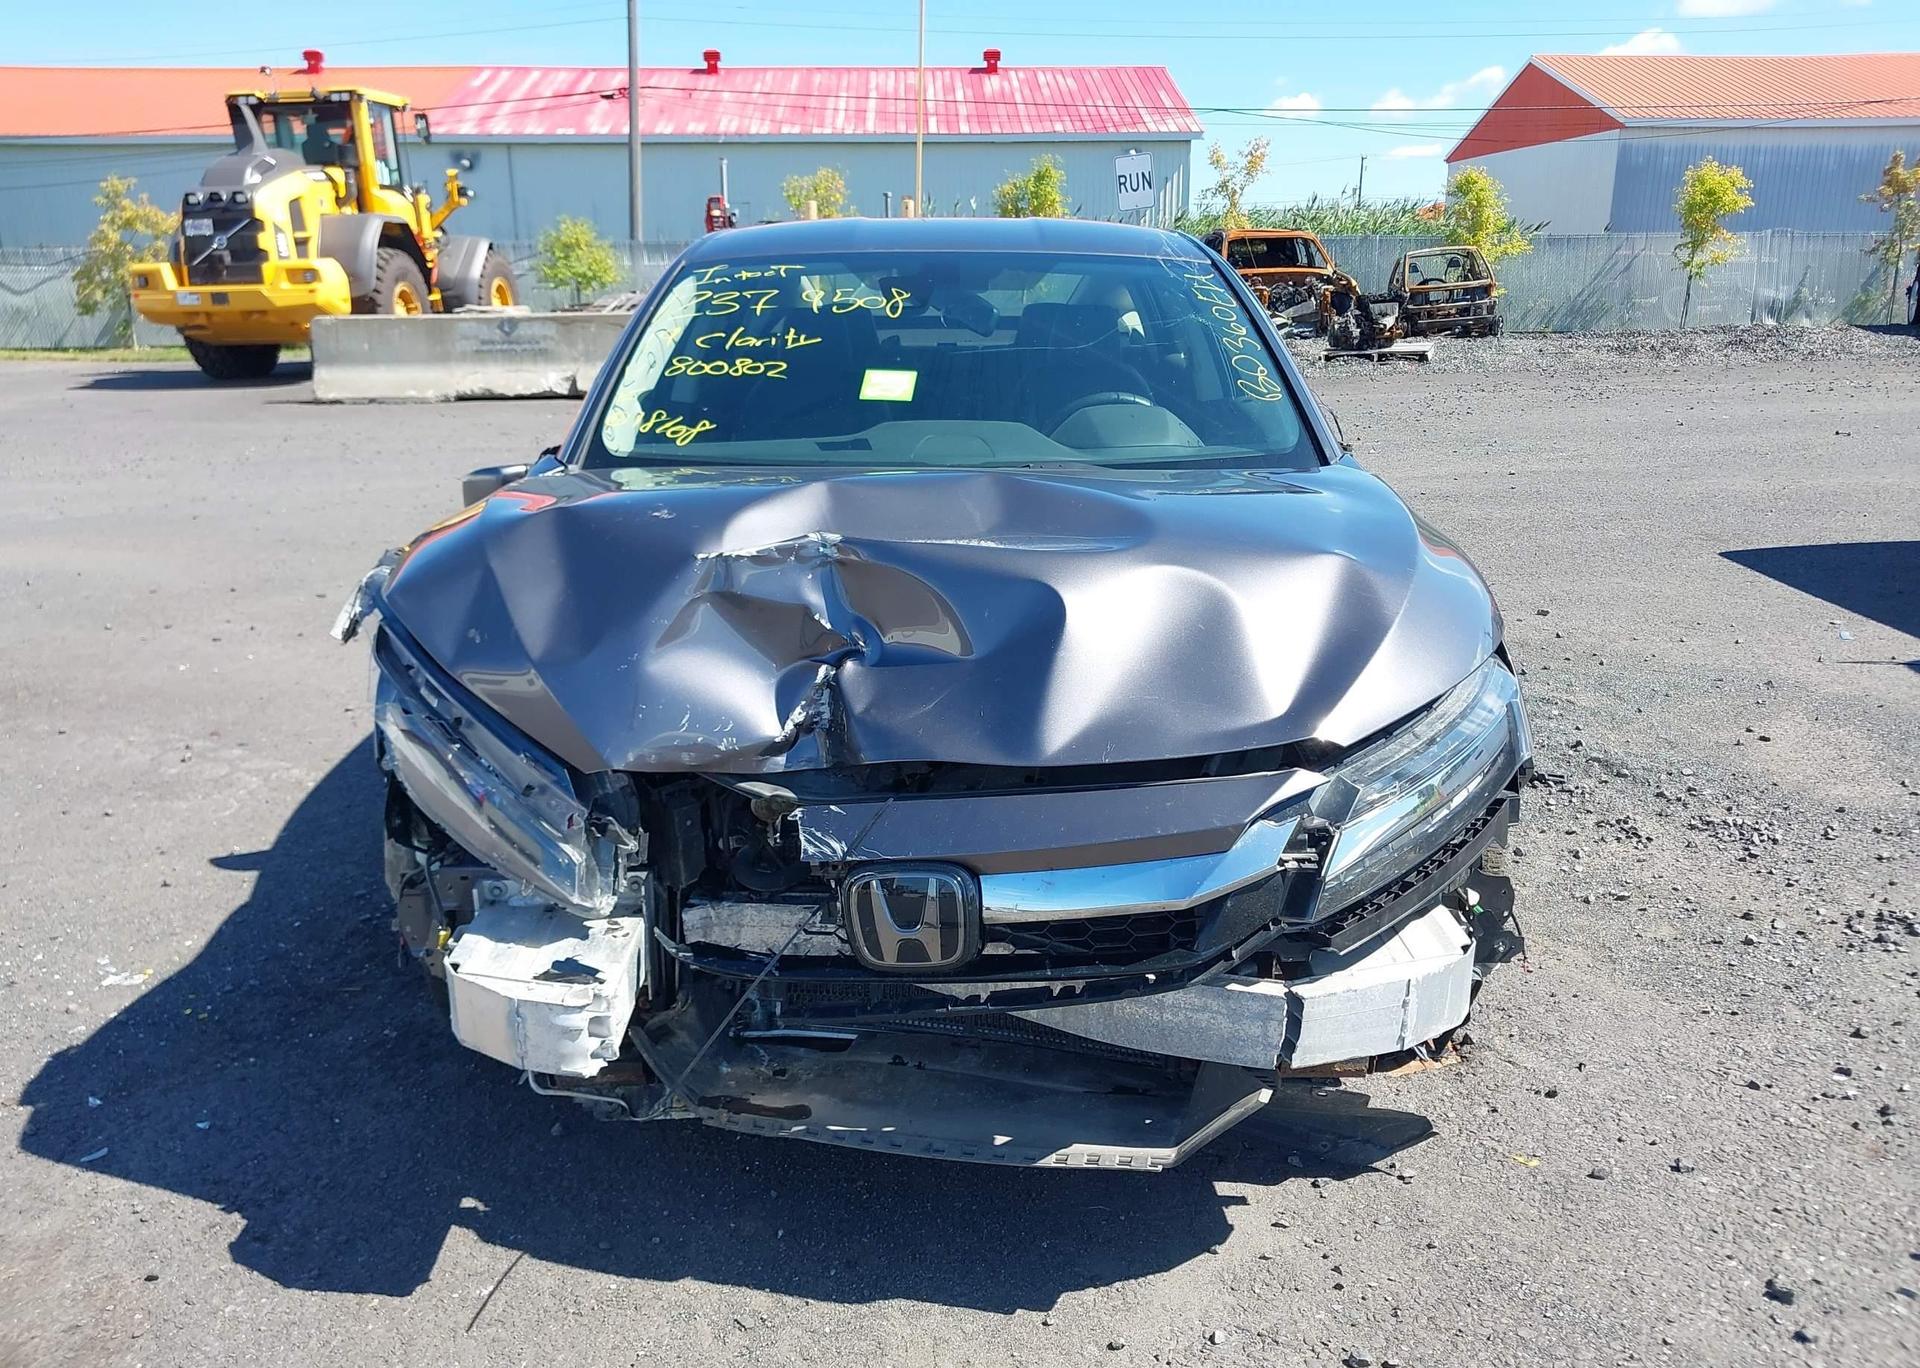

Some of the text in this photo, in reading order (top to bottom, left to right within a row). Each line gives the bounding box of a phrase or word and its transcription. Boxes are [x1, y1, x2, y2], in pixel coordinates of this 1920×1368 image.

[1118, 170, 1152, 194] RUN
[801, 287, 911, 318] 9508
[695, 326, 823, 350] Clarity
[664, 355, 788, 379] 800802
